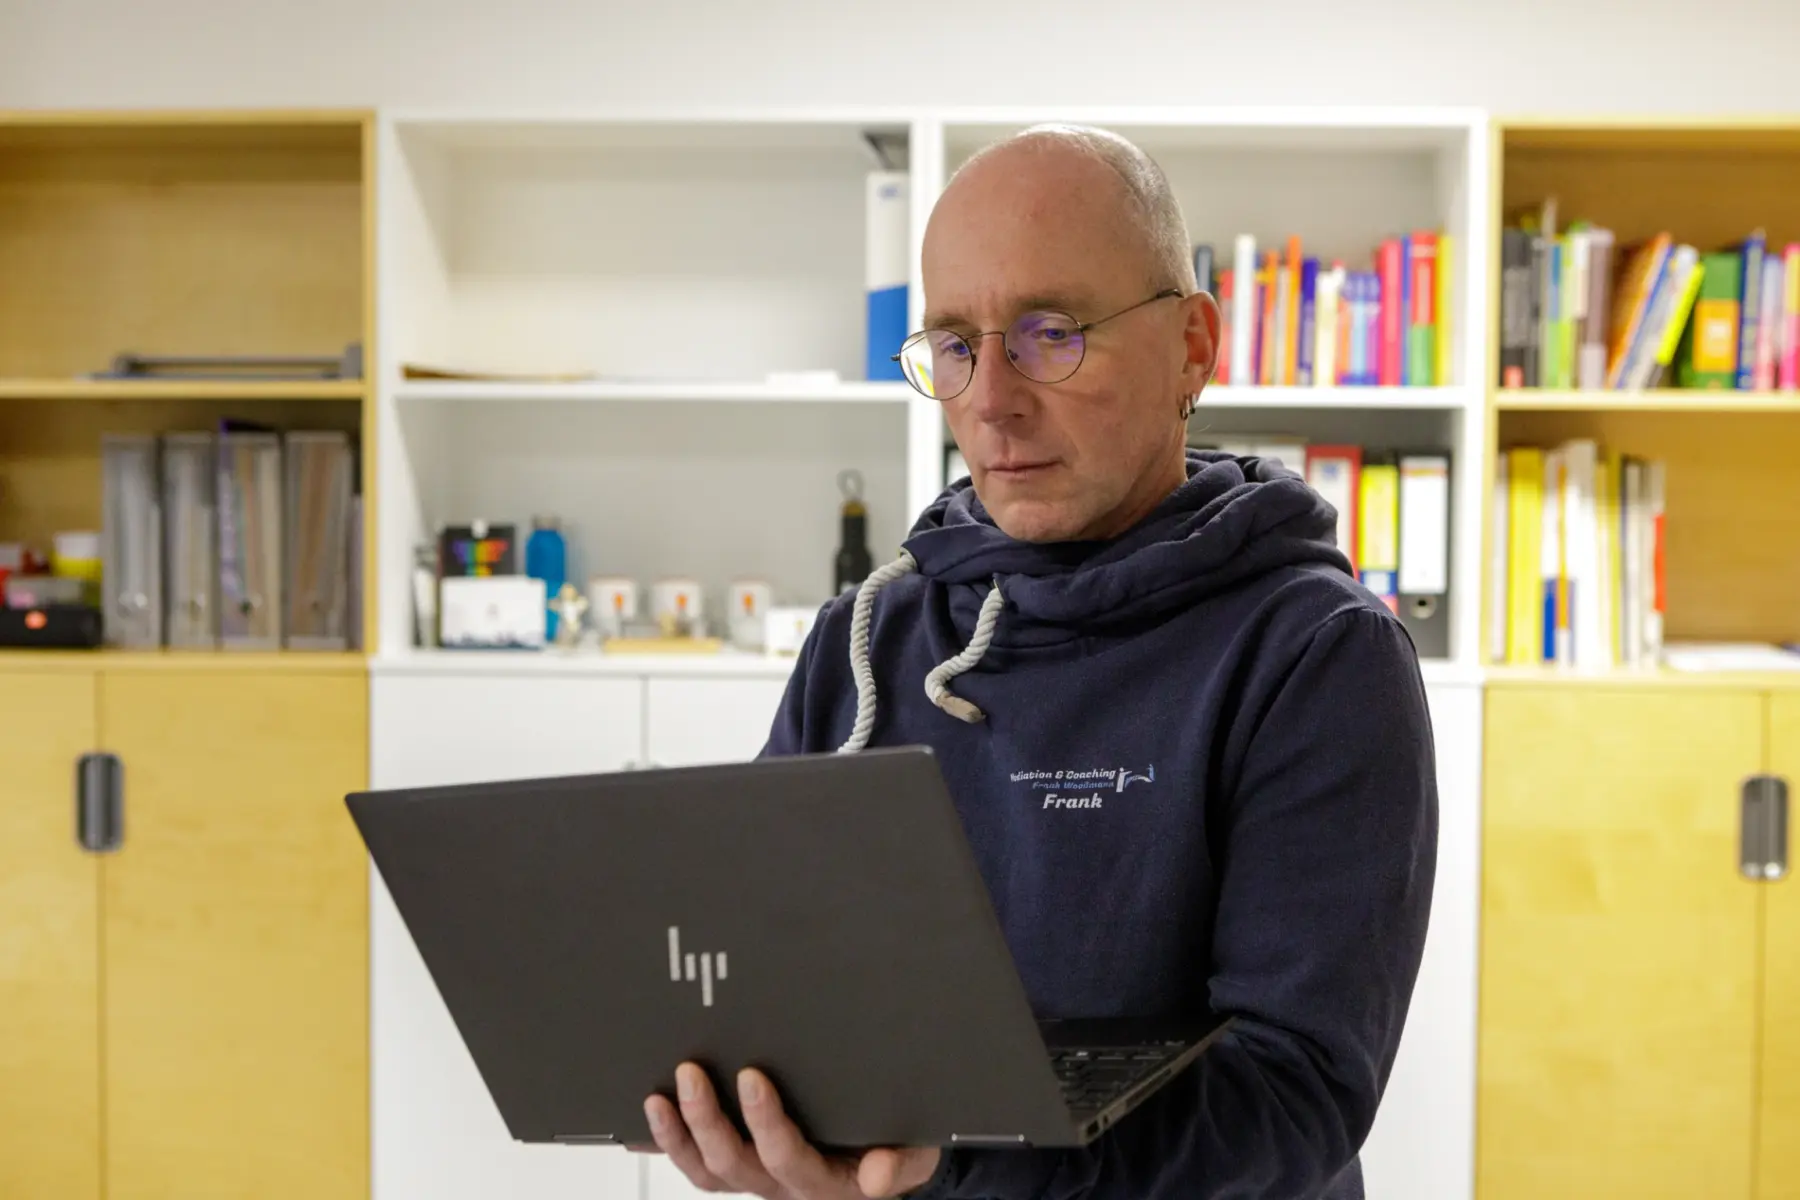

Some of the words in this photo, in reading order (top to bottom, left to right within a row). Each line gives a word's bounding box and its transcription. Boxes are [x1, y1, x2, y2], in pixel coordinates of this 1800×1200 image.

[1055, 770, 1064, 779] &
[1066, 768, 1116, 780] Coaching
[1043, 793, 1103, 809] Frank
